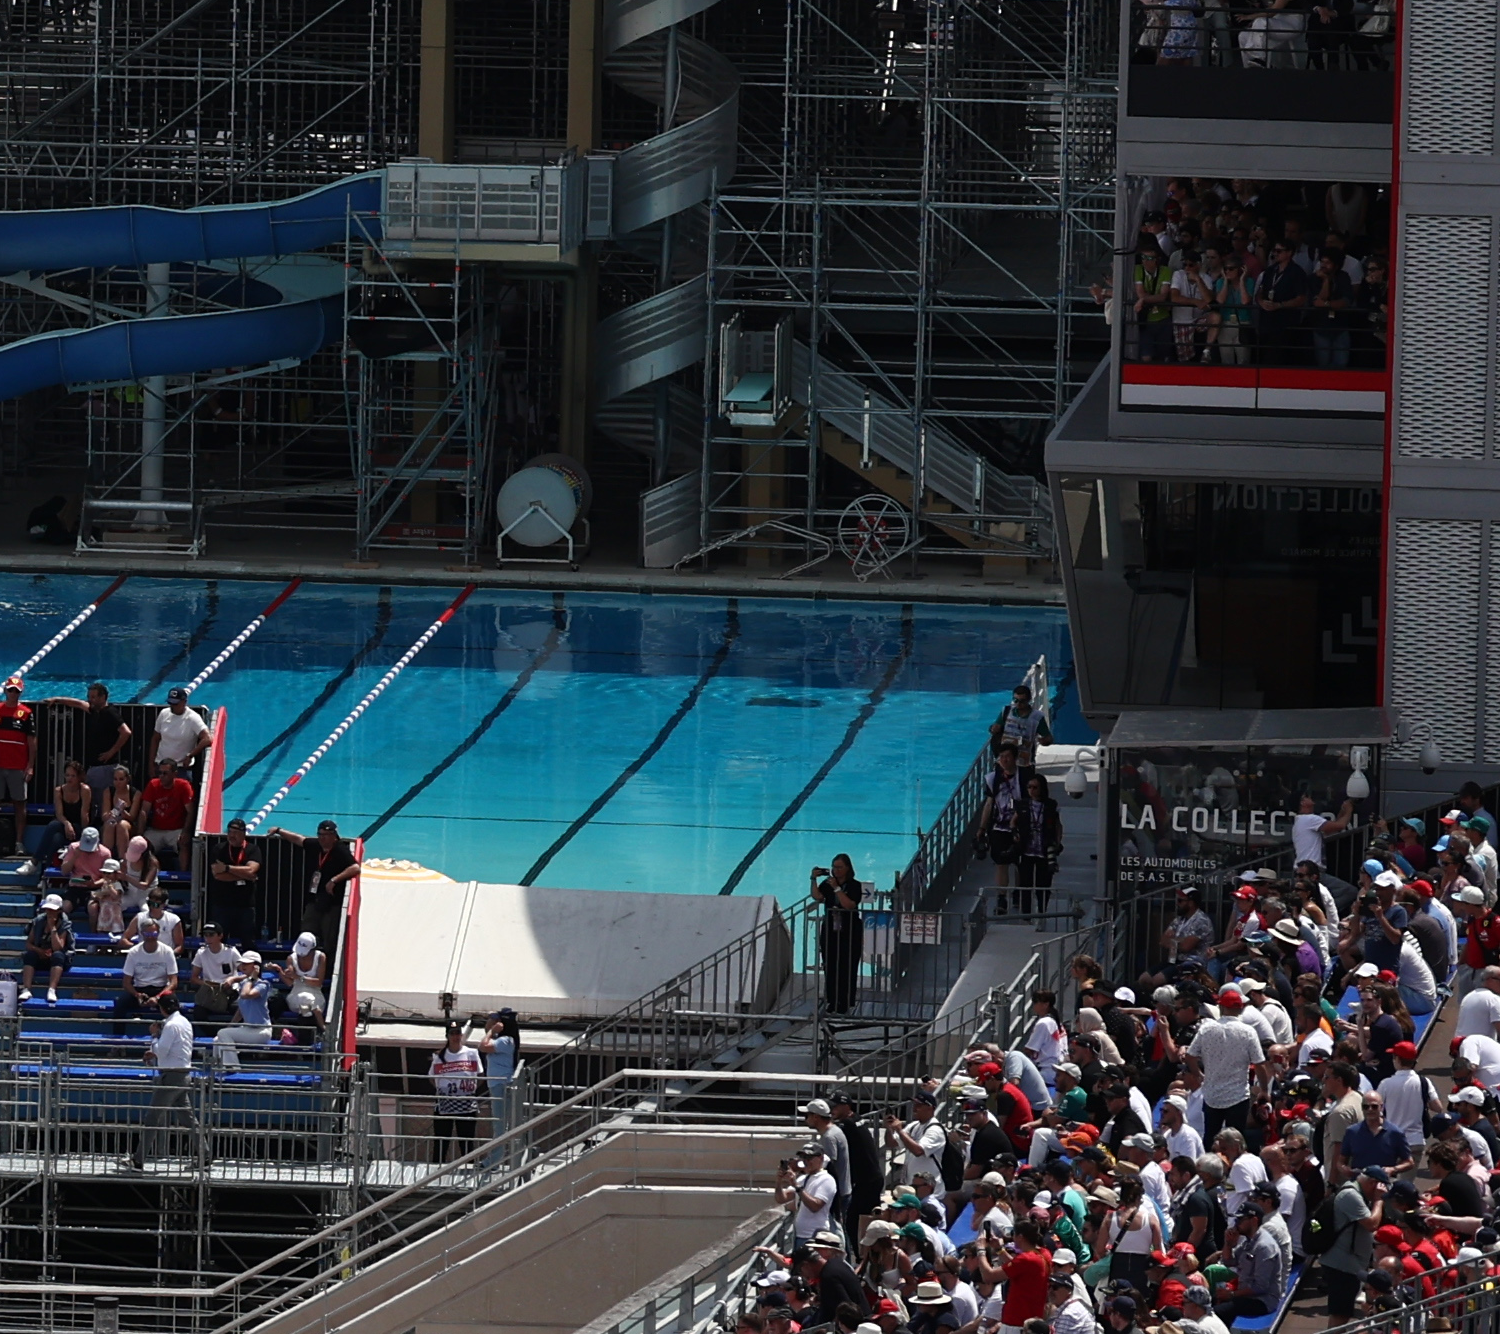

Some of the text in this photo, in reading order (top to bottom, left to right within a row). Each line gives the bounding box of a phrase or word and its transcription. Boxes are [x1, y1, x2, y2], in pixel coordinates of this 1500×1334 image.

[1121, 803, 1290, 837] LA COLLEC
[1120, 856, 1217, 869] LES AUTOMOBILES
[1120, 871, 1134, 882] DE
[1138, 871, 1169, 883] S.A.S.
